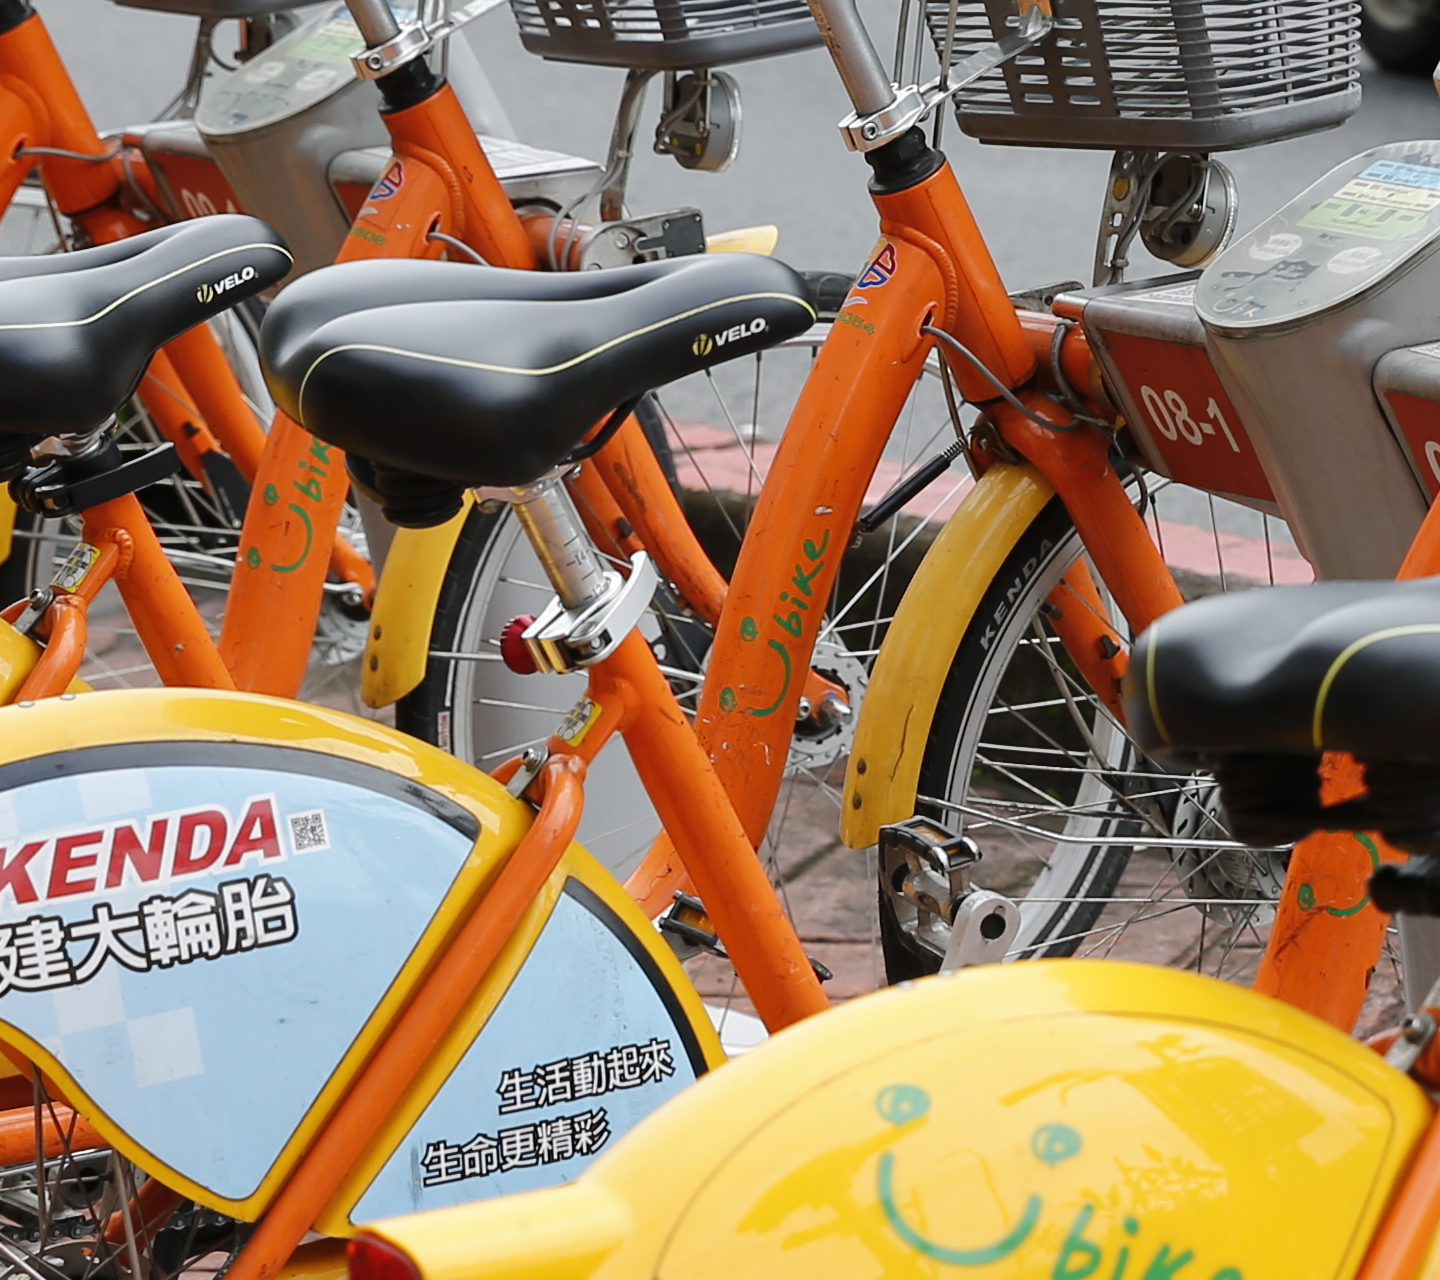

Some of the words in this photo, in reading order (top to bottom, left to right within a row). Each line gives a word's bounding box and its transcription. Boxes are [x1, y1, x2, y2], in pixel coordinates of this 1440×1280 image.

[214, 266, 255, 295] VELO
[715, 318, 766, 346] VELO
[1140, 384, 1240, 454] 08-1
[980, 539, 1053, 651] KENDA
[494, 1039, 677, 1119] 生活動起來
[419, 1112, 611, 1188] 生命更精彩
